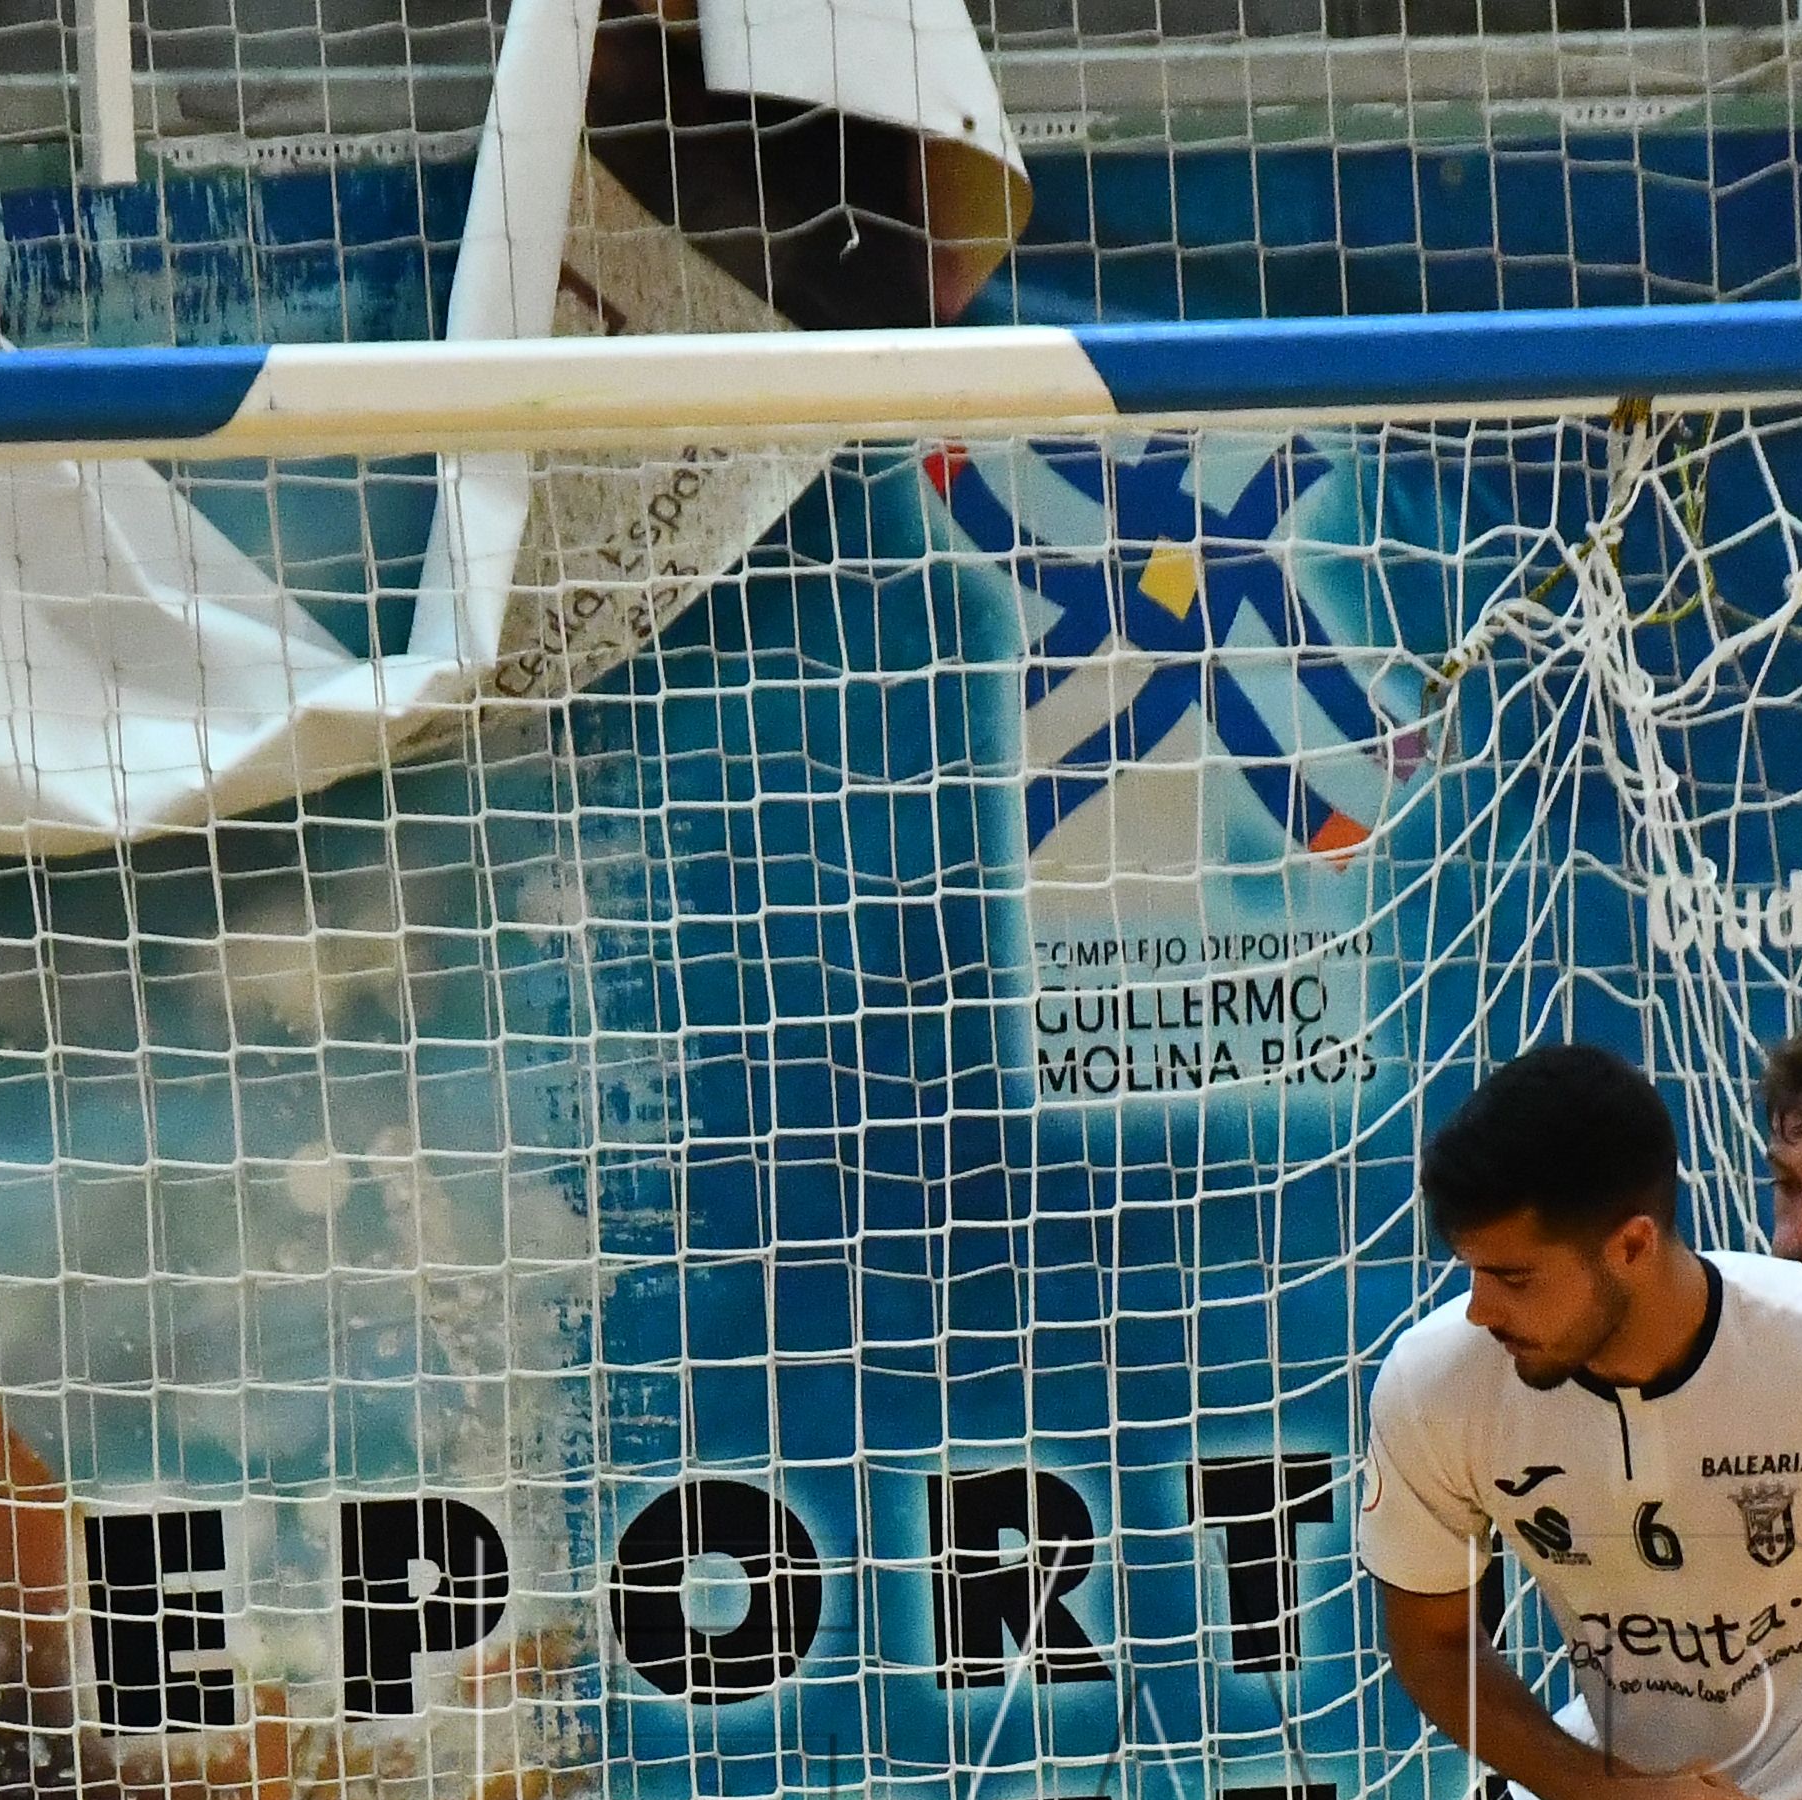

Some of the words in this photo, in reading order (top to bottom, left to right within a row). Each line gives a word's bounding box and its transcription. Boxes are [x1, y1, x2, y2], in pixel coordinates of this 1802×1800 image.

[1034, 936, 1187, 968] COMPLEJO
[1035, 974, 1328, 1035] GUILLERMO
[1038, 1040, 1241, 1095] MOLINA
[1261, 1023, 1378, 1085] RÍOS
[1633, 1500, 1684, 1572] 6
